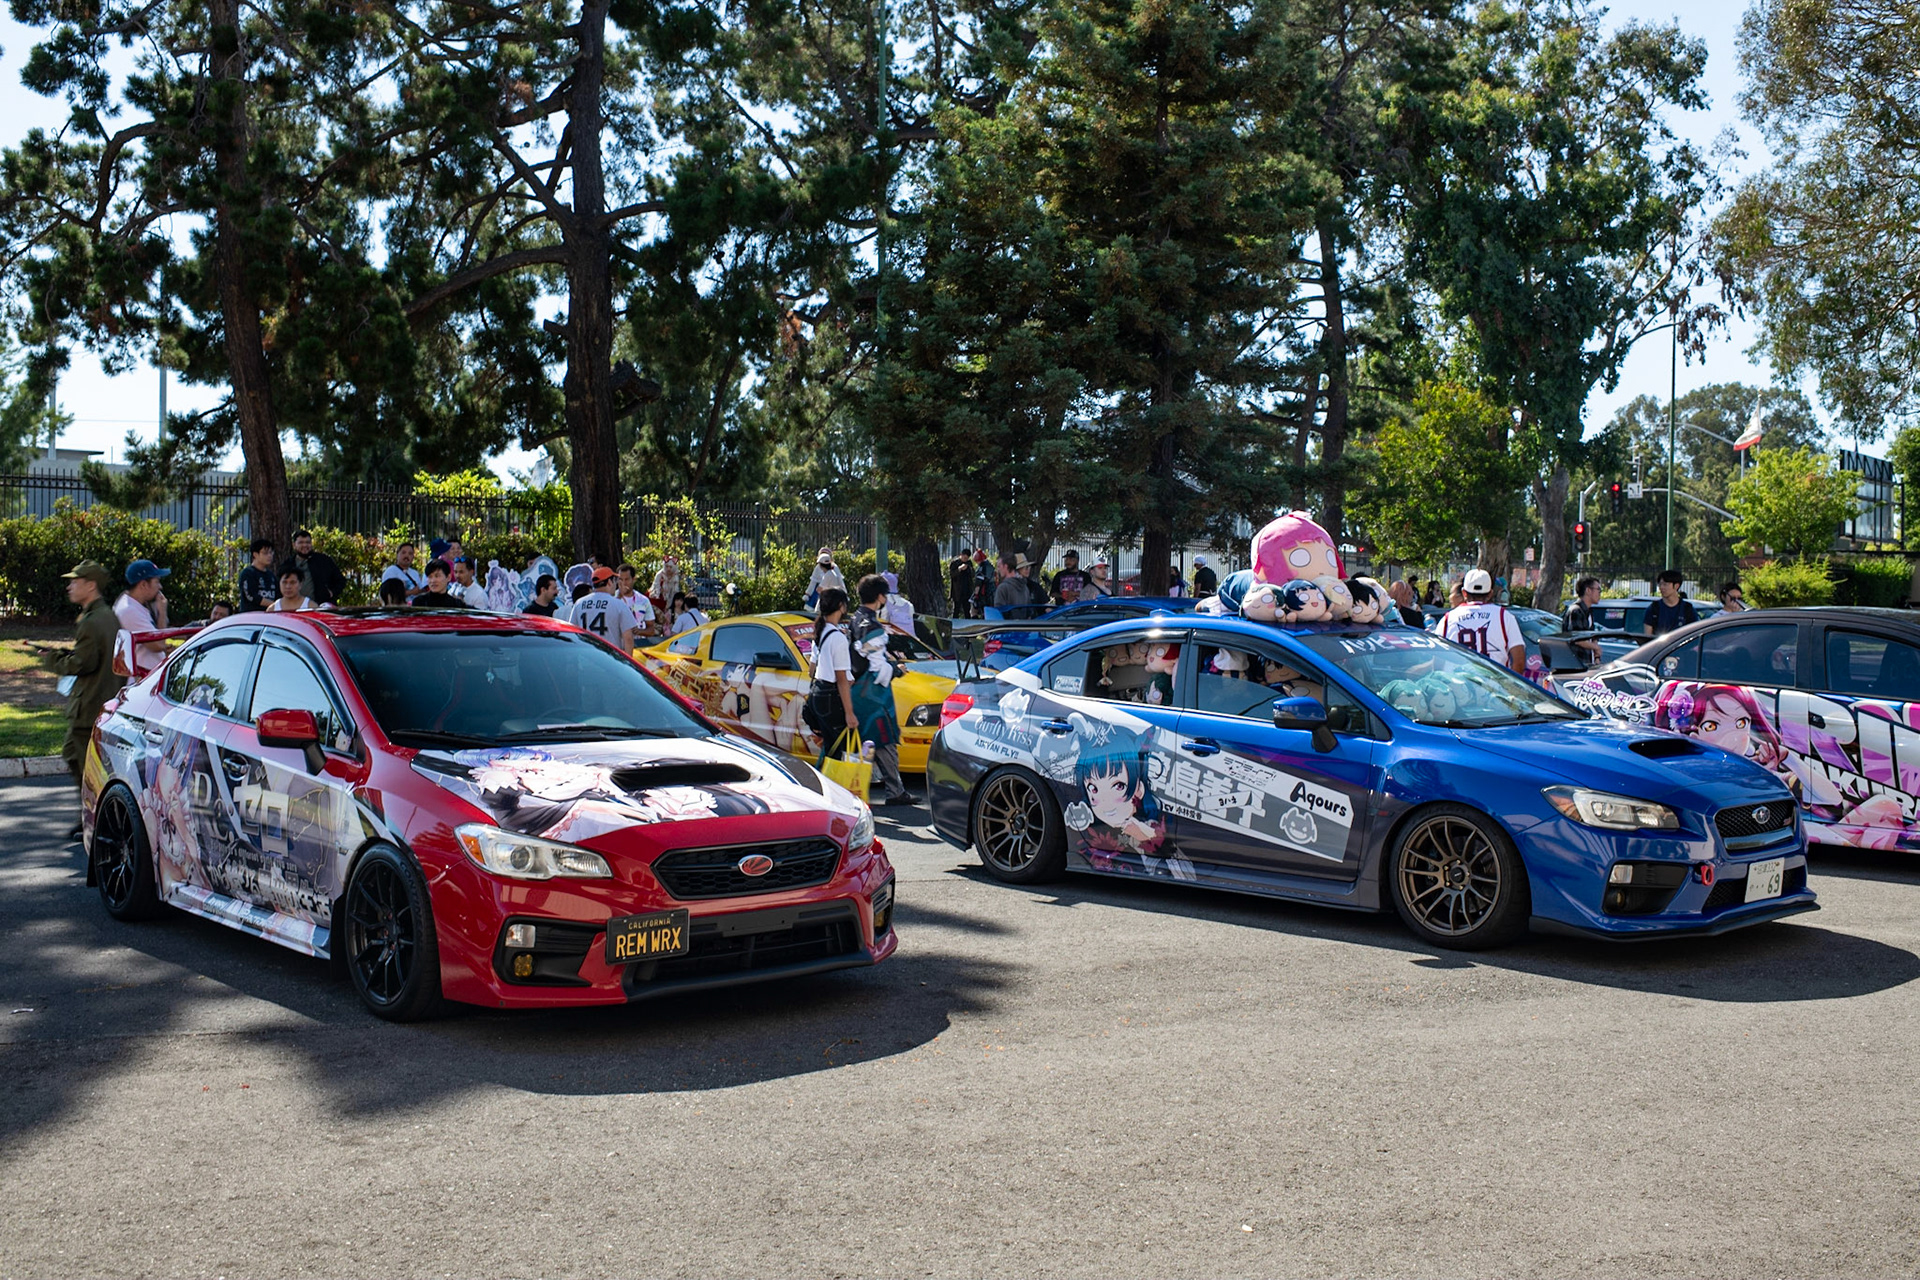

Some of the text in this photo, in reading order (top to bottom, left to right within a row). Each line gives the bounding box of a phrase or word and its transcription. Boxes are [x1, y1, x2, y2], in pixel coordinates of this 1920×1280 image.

[580, 612, 607, 636] 14
[1458, 612, 1491, 622] FUCK YOU
[974, 715, 1034, 746] Guilty Kiss
[1164, 803, 1173, 812] CV
[1290, 781, 1347, 817] Aqours
[1767, 873, 1780, 894] 69
[628, 918, 671, 929] CALIFORNIA
[615, 927, 681, 958] REM WRX
